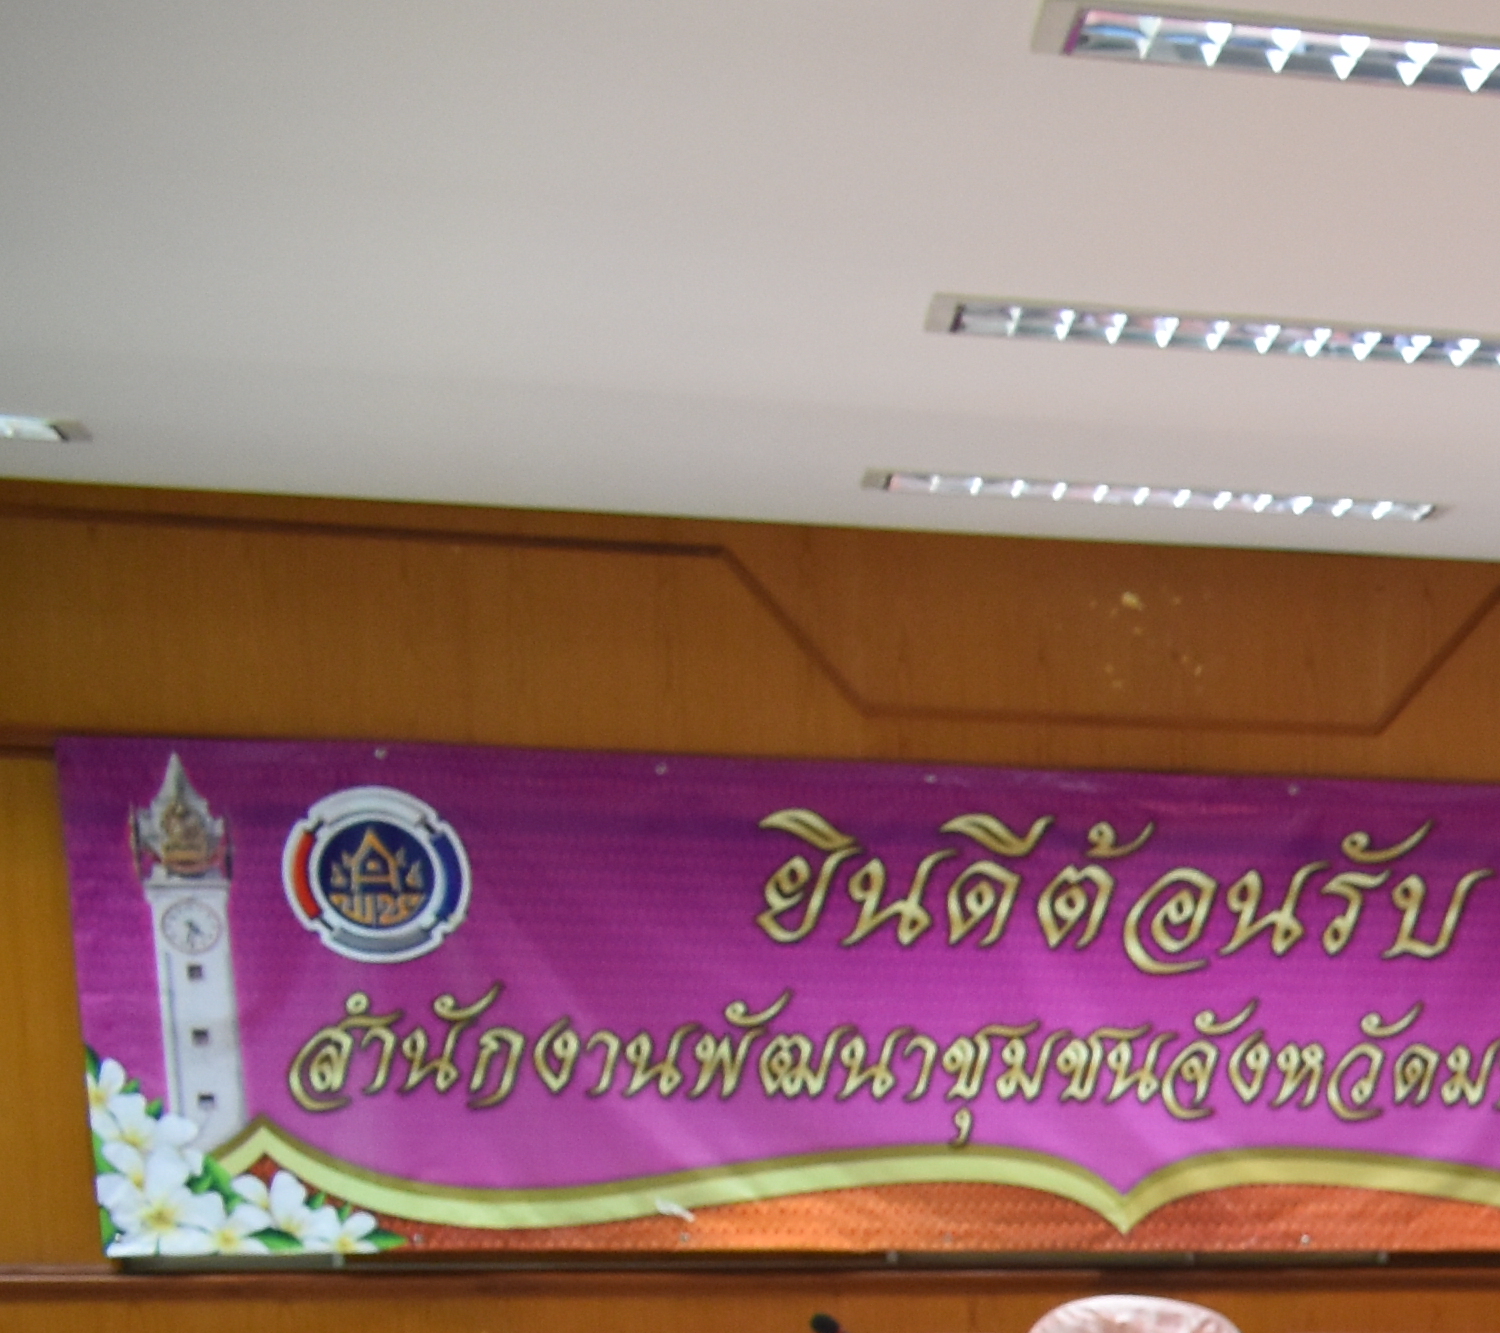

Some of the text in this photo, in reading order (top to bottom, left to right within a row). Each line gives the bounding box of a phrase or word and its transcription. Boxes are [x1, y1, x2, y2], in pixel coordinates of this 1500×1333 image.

[757, 806, 1495, 975] ยินดีต้อนรับ
